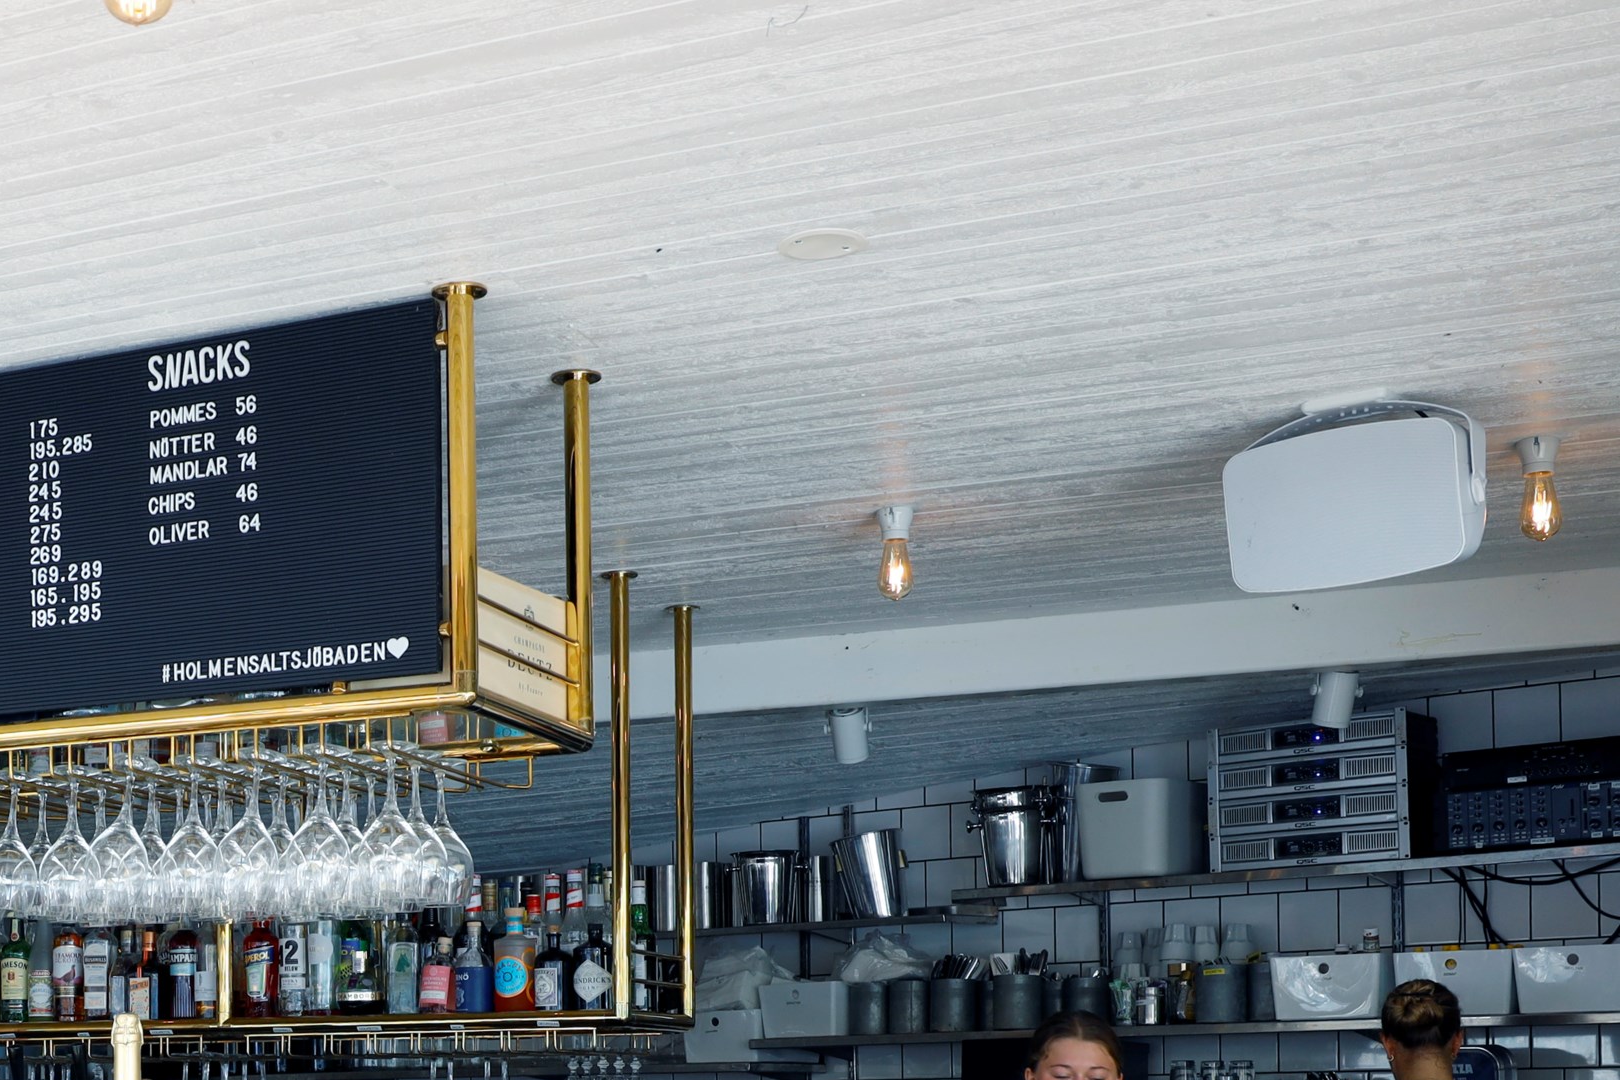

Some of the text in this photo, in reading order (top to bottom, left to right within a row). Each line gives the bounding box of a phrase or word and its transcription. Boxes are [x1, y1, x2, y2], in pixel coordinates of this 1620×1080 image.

[147, 340, 251, 392] SNACKS
[150, 395, 257, 428] POMMES 56
[30, 418, 58, 439] 175
[149, 425, 257, 459] NÖTTER 46
[29, 461, 60, 481] 210
[150, 452, 257, 485] MANDLAR 74
[29, 481, 61, 502] 245
[148, 483, 258, 515] CHIPS 46
[29, 502, 62, 523] 245
[30, 523, 61, 544] 275
[149, 513, 261, 545] OLIVER 64
[30, 544, 61, 565] 269
